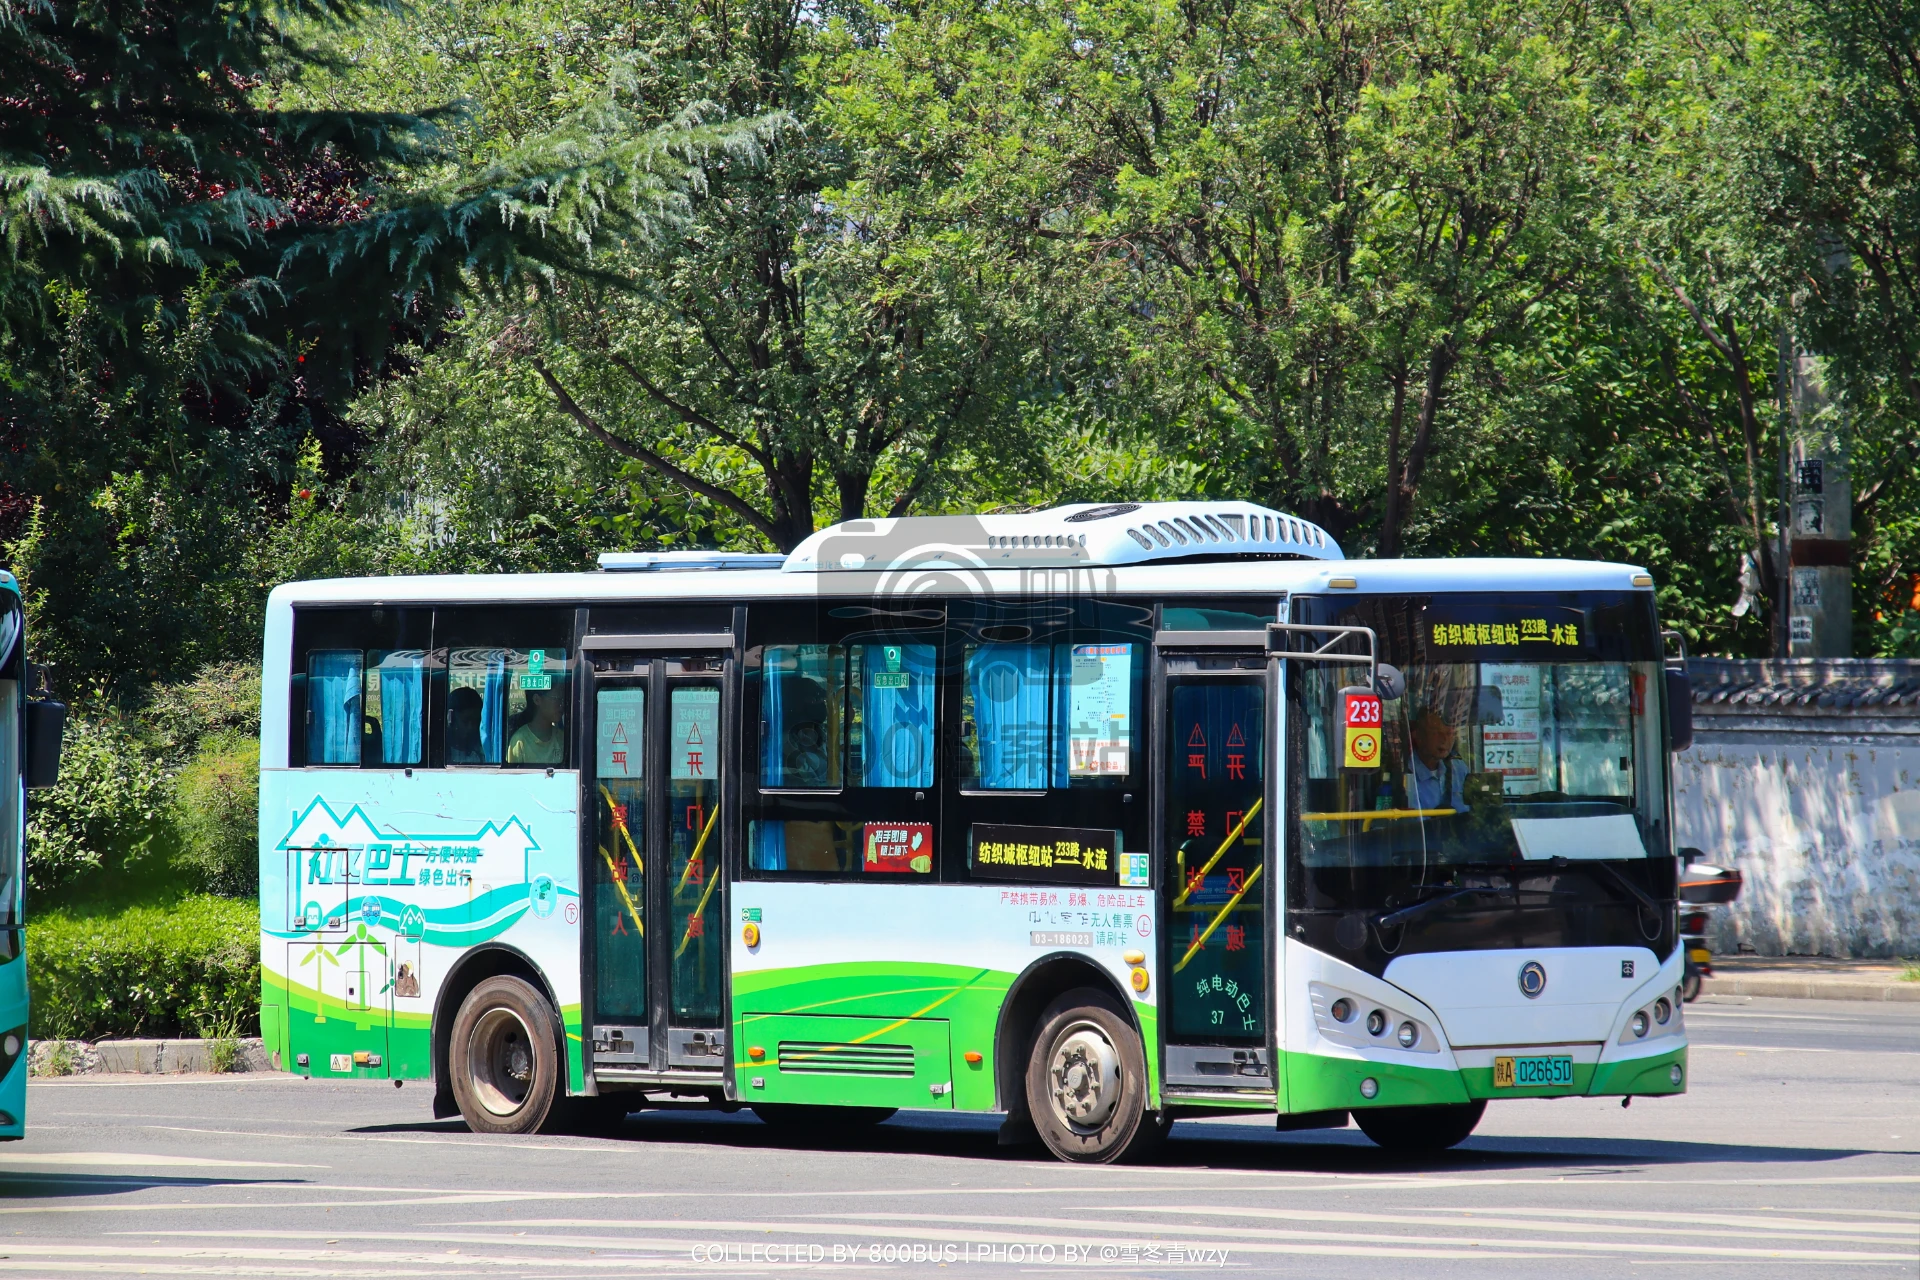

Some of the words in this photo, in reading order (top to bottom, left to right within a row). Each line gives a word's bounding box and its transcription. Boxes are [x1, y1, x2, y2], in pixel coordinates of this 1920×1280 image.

[1433, 623, 1519, 646] 纺织城枢纽站
[1521, 619, 1548, 634] 233路
[1551, 624, 1579, 646] 水流
[876, 675, 900, 686] 应急出口
[1350, 701, 1380, 723] 233
[1487, 750, 1514, 764] 275
[875, 830, 908, 843] 招手即停
[308, 841, 416, 886] 社区巴士
[424, 846, 482, 864] 方便快捷
[978, 842, 1053, 867] 纺织城枢纽站
[1055, 841, 1081, 858] 233路
[1082, 848, 1108, 870] 水流
[418, 868, 472, 887] 绿色出行
[1090, 912, 1133, 929] 无人售票
[1035, 933, 1090, 945] 03-186023
[1096, 931, 1128, 946] 请刷卡
[1196, 974, 1256, 1031] 纯电动巴士
[1211, 1010, 1224, 1025] 37
